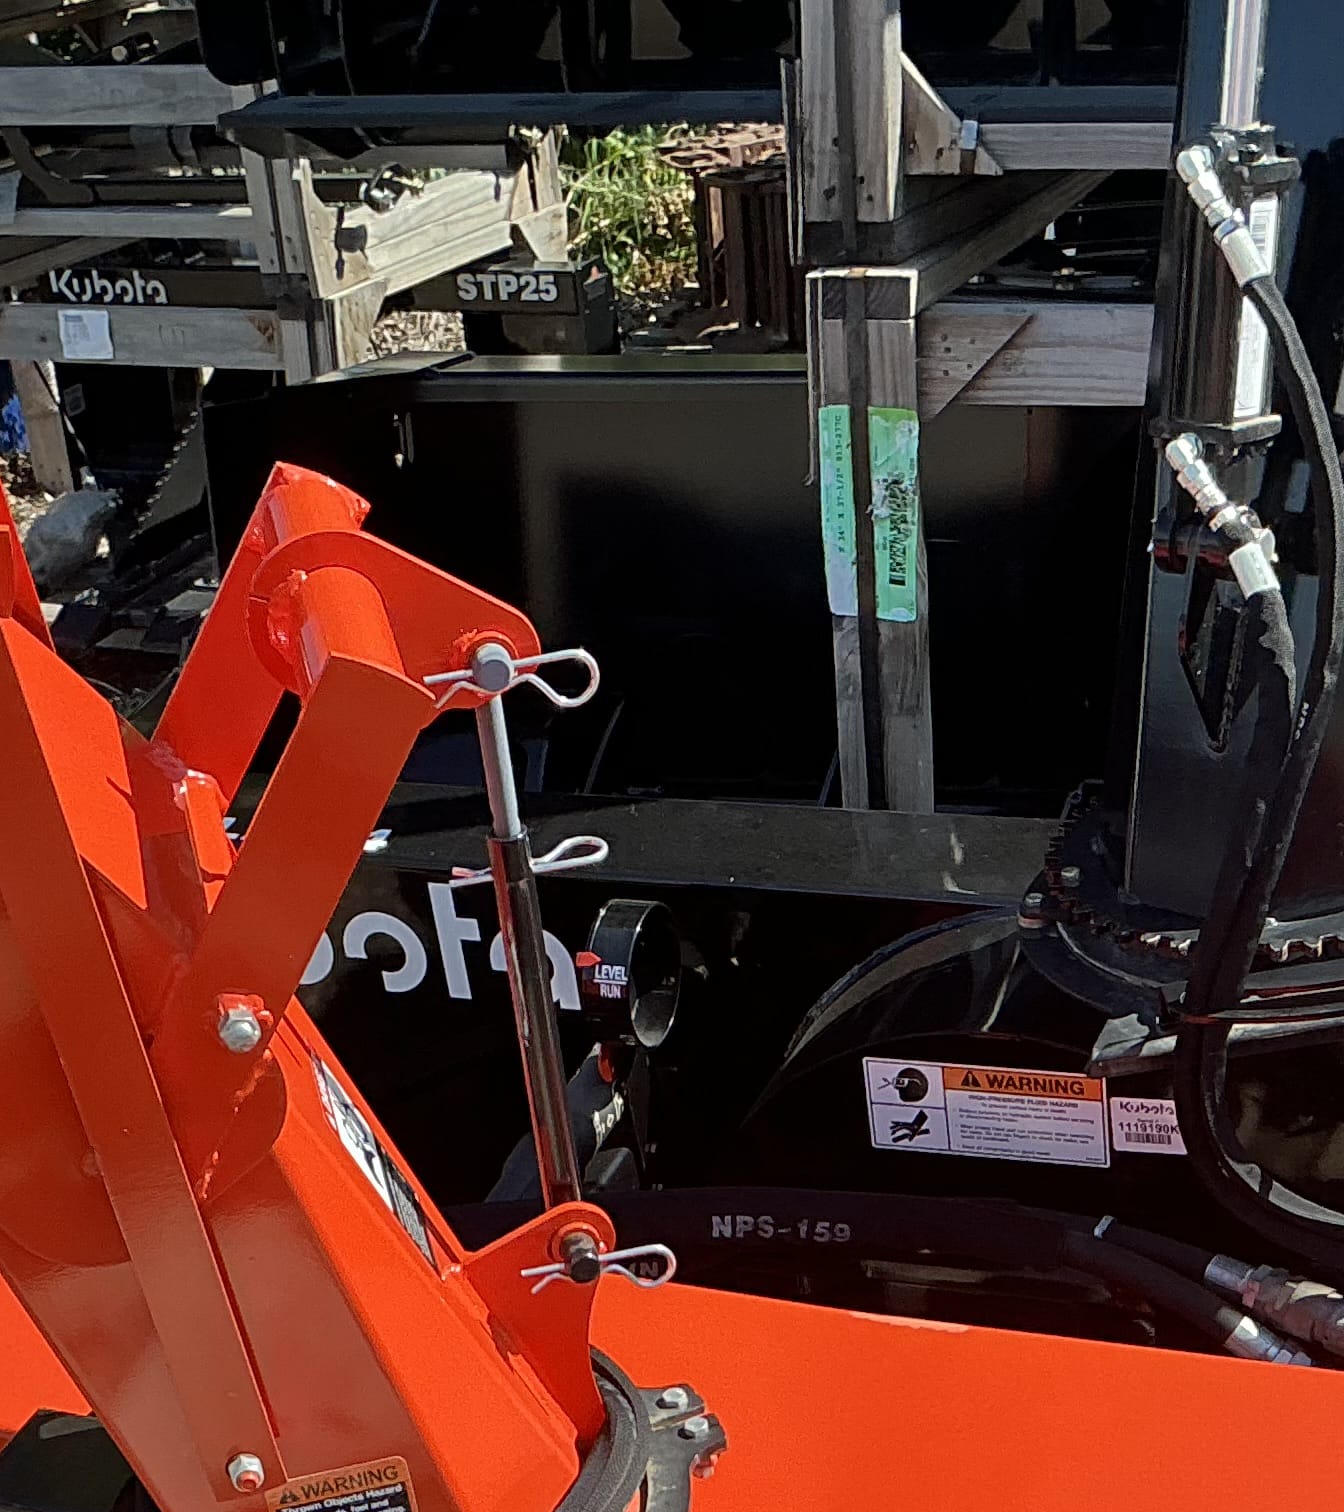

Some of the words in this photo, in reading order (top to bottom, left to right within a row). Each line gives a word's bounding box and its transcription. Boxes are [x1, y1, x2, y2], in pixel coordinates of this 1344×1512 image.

[48, 269, 169, 304] Kubota
[456, 272, 558, 302] STP25
[594, 964, 628, 981] LEVEL
[599, 984, 622, 999] RUN
[985, 1073, 1085, 1096] WARNING
[1119, 1101, 1175, 1115] Kubota
[711, 1214, 852, 1243] NPS-159
[301, 1465, 399, 1499] WARNING
[323, 1492, 365, 1509] Objects
[370, 1499, 389, 1510] and
